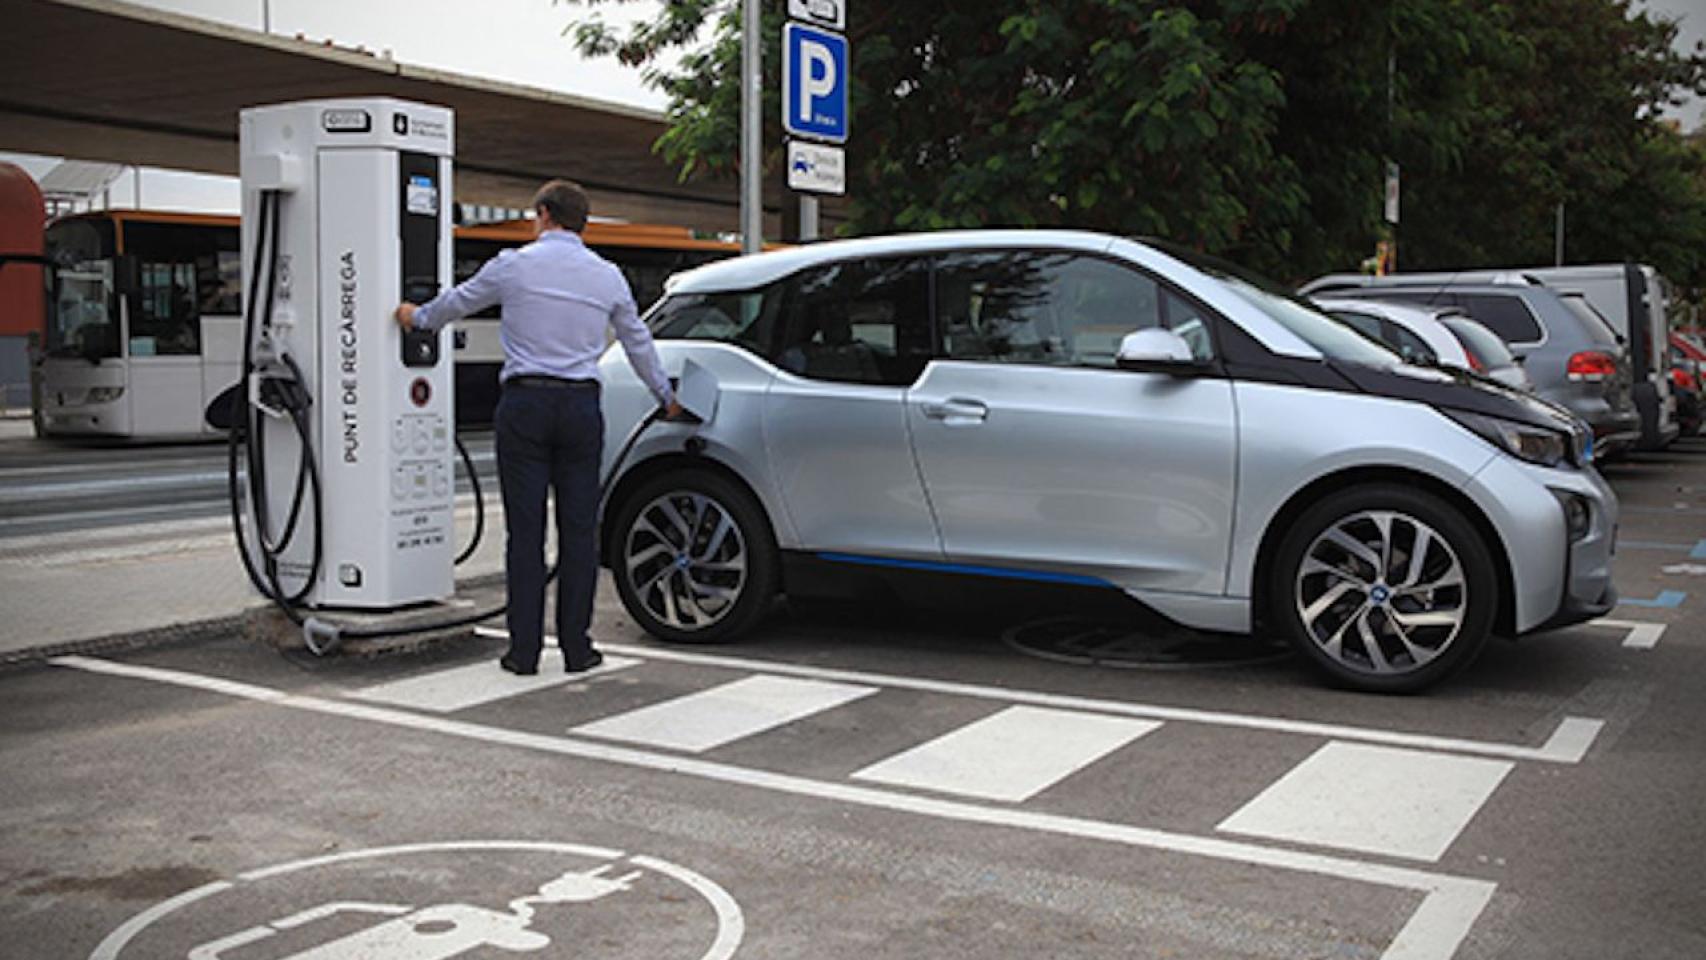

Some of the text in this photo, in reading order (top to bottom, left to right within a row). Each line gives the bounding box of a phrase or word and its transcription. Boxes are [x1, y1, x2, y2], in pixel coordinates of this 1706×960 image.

[800, 39, 836, 122] P
[340, 251, 359, 463] PUNT DE RECARREGA
